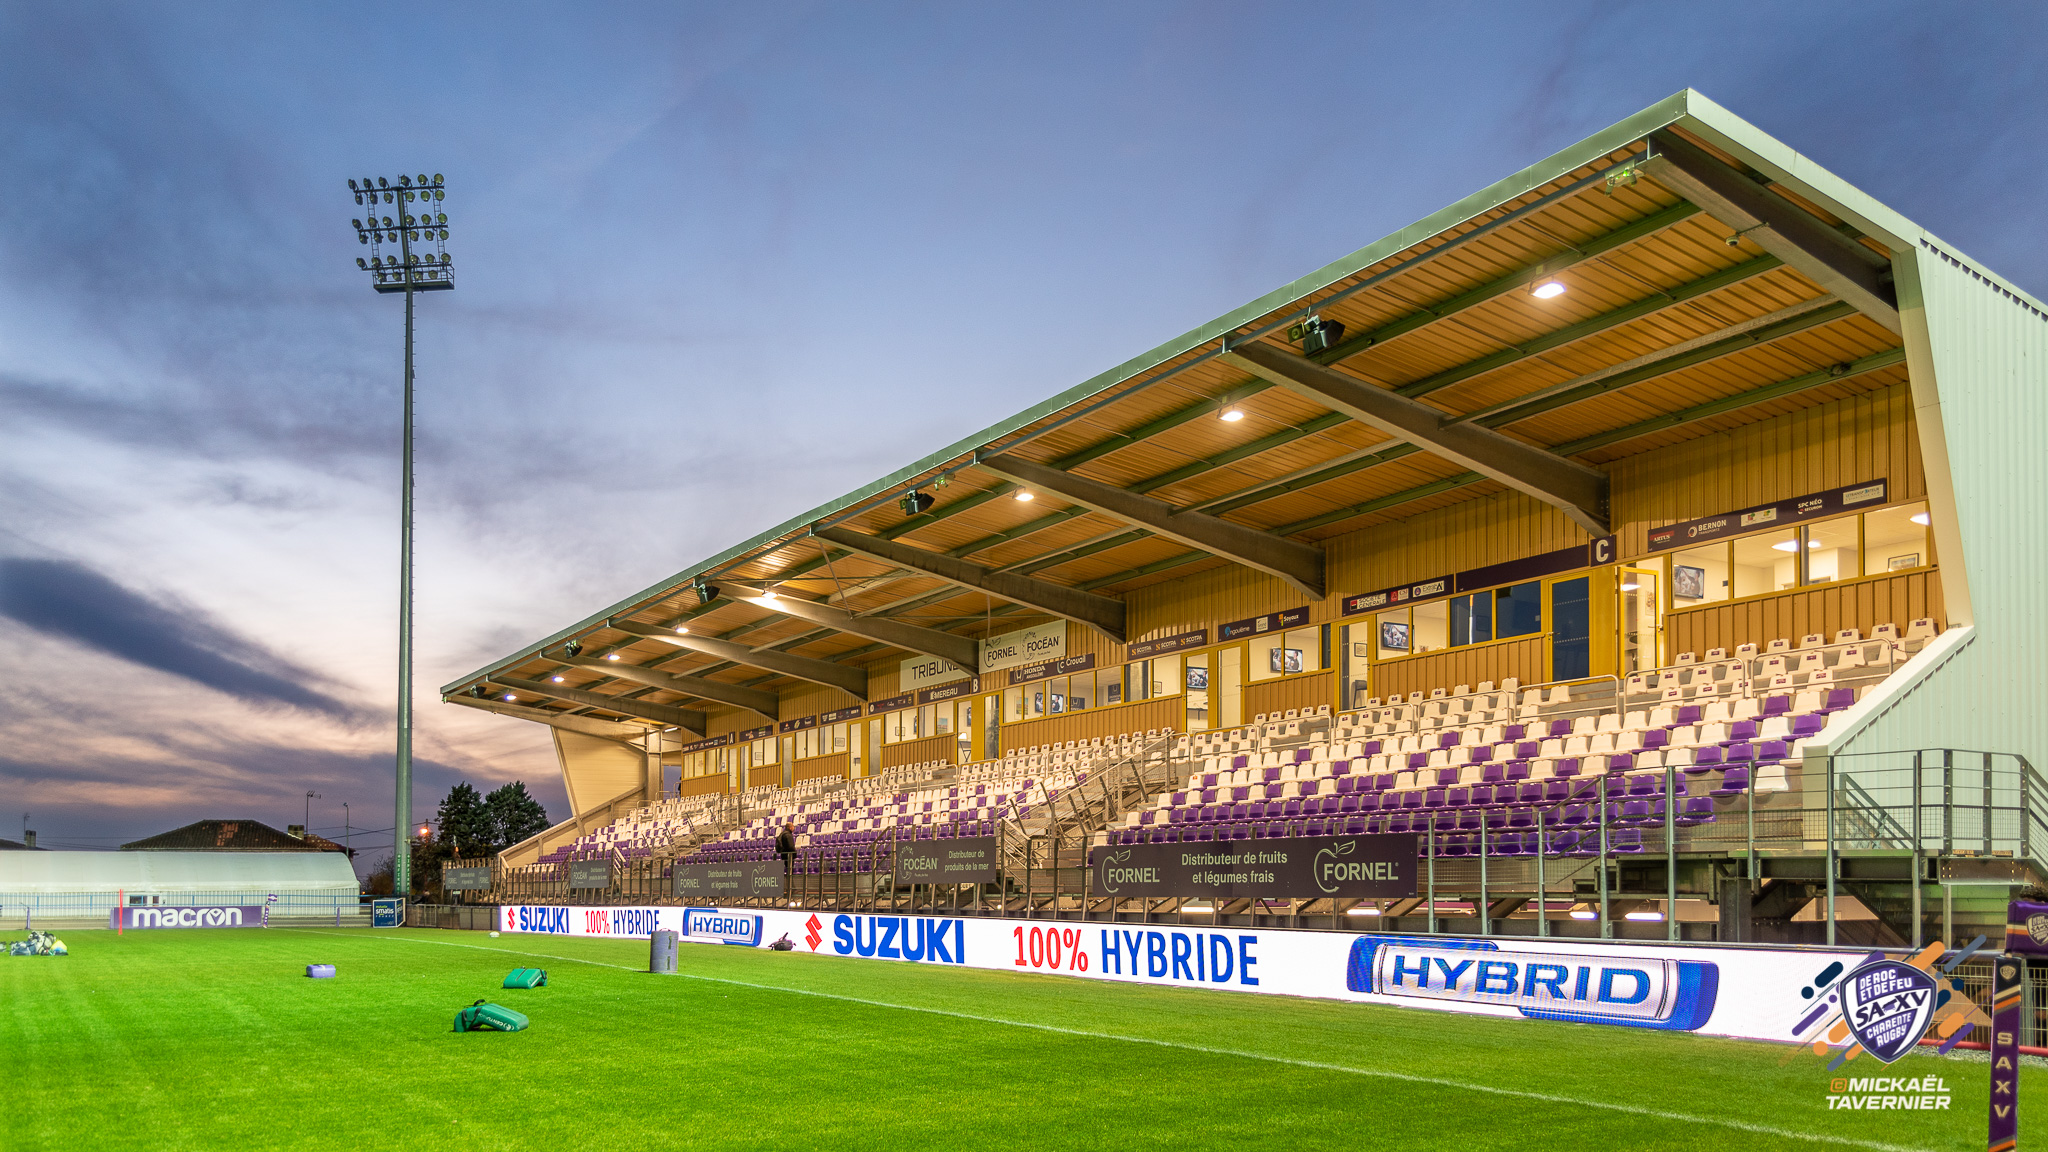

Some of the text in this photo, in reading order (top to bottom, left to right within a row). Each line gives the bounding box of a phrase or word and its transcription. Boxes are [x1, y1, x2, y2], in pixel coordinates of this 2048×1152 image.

[1797, 501, 1809, 509] SPC
[1698, 519, 1727, 532] BERNON
[1595, 539, 1609, 562] C
[1026, 635, 1059, 653] FOCÉAN
[987, 645, 1018, 662] FORNEL
[1023, 665, 1046, 675] HONDA
[972, 678, 979, 693] B
[729, 733, 734, 744] A
[948, 849, 985, 859] Distributeur de
[1181, 850, 1288, 867] Distributeur de fruits
[903, 855, 938, 871] FOCÉAN
[944, 862, 964, 873] produits
[965, 862, 972, 871] de
[972, 862, 978, 870] la
[1108, 867, 1160, 884] FORNEL
[1192, 869, 1275, 887] et légumes frais
[1323, 861, 1399, 883] FORNEL
[754, 876, 779, 888] FORNEL
[132, 908, 243, 928] macron
[519, 906, 570, 934] SUZUKI
[585, 910, 611, 934] 100%
[693, 916, 749, 936] HYBRID
[833, 914, 965, 964] SUZUKI
[1013, 926, 1259, 986] 100% HYBRIDE
[1392, 955, 1651, 1005] HYBRID
